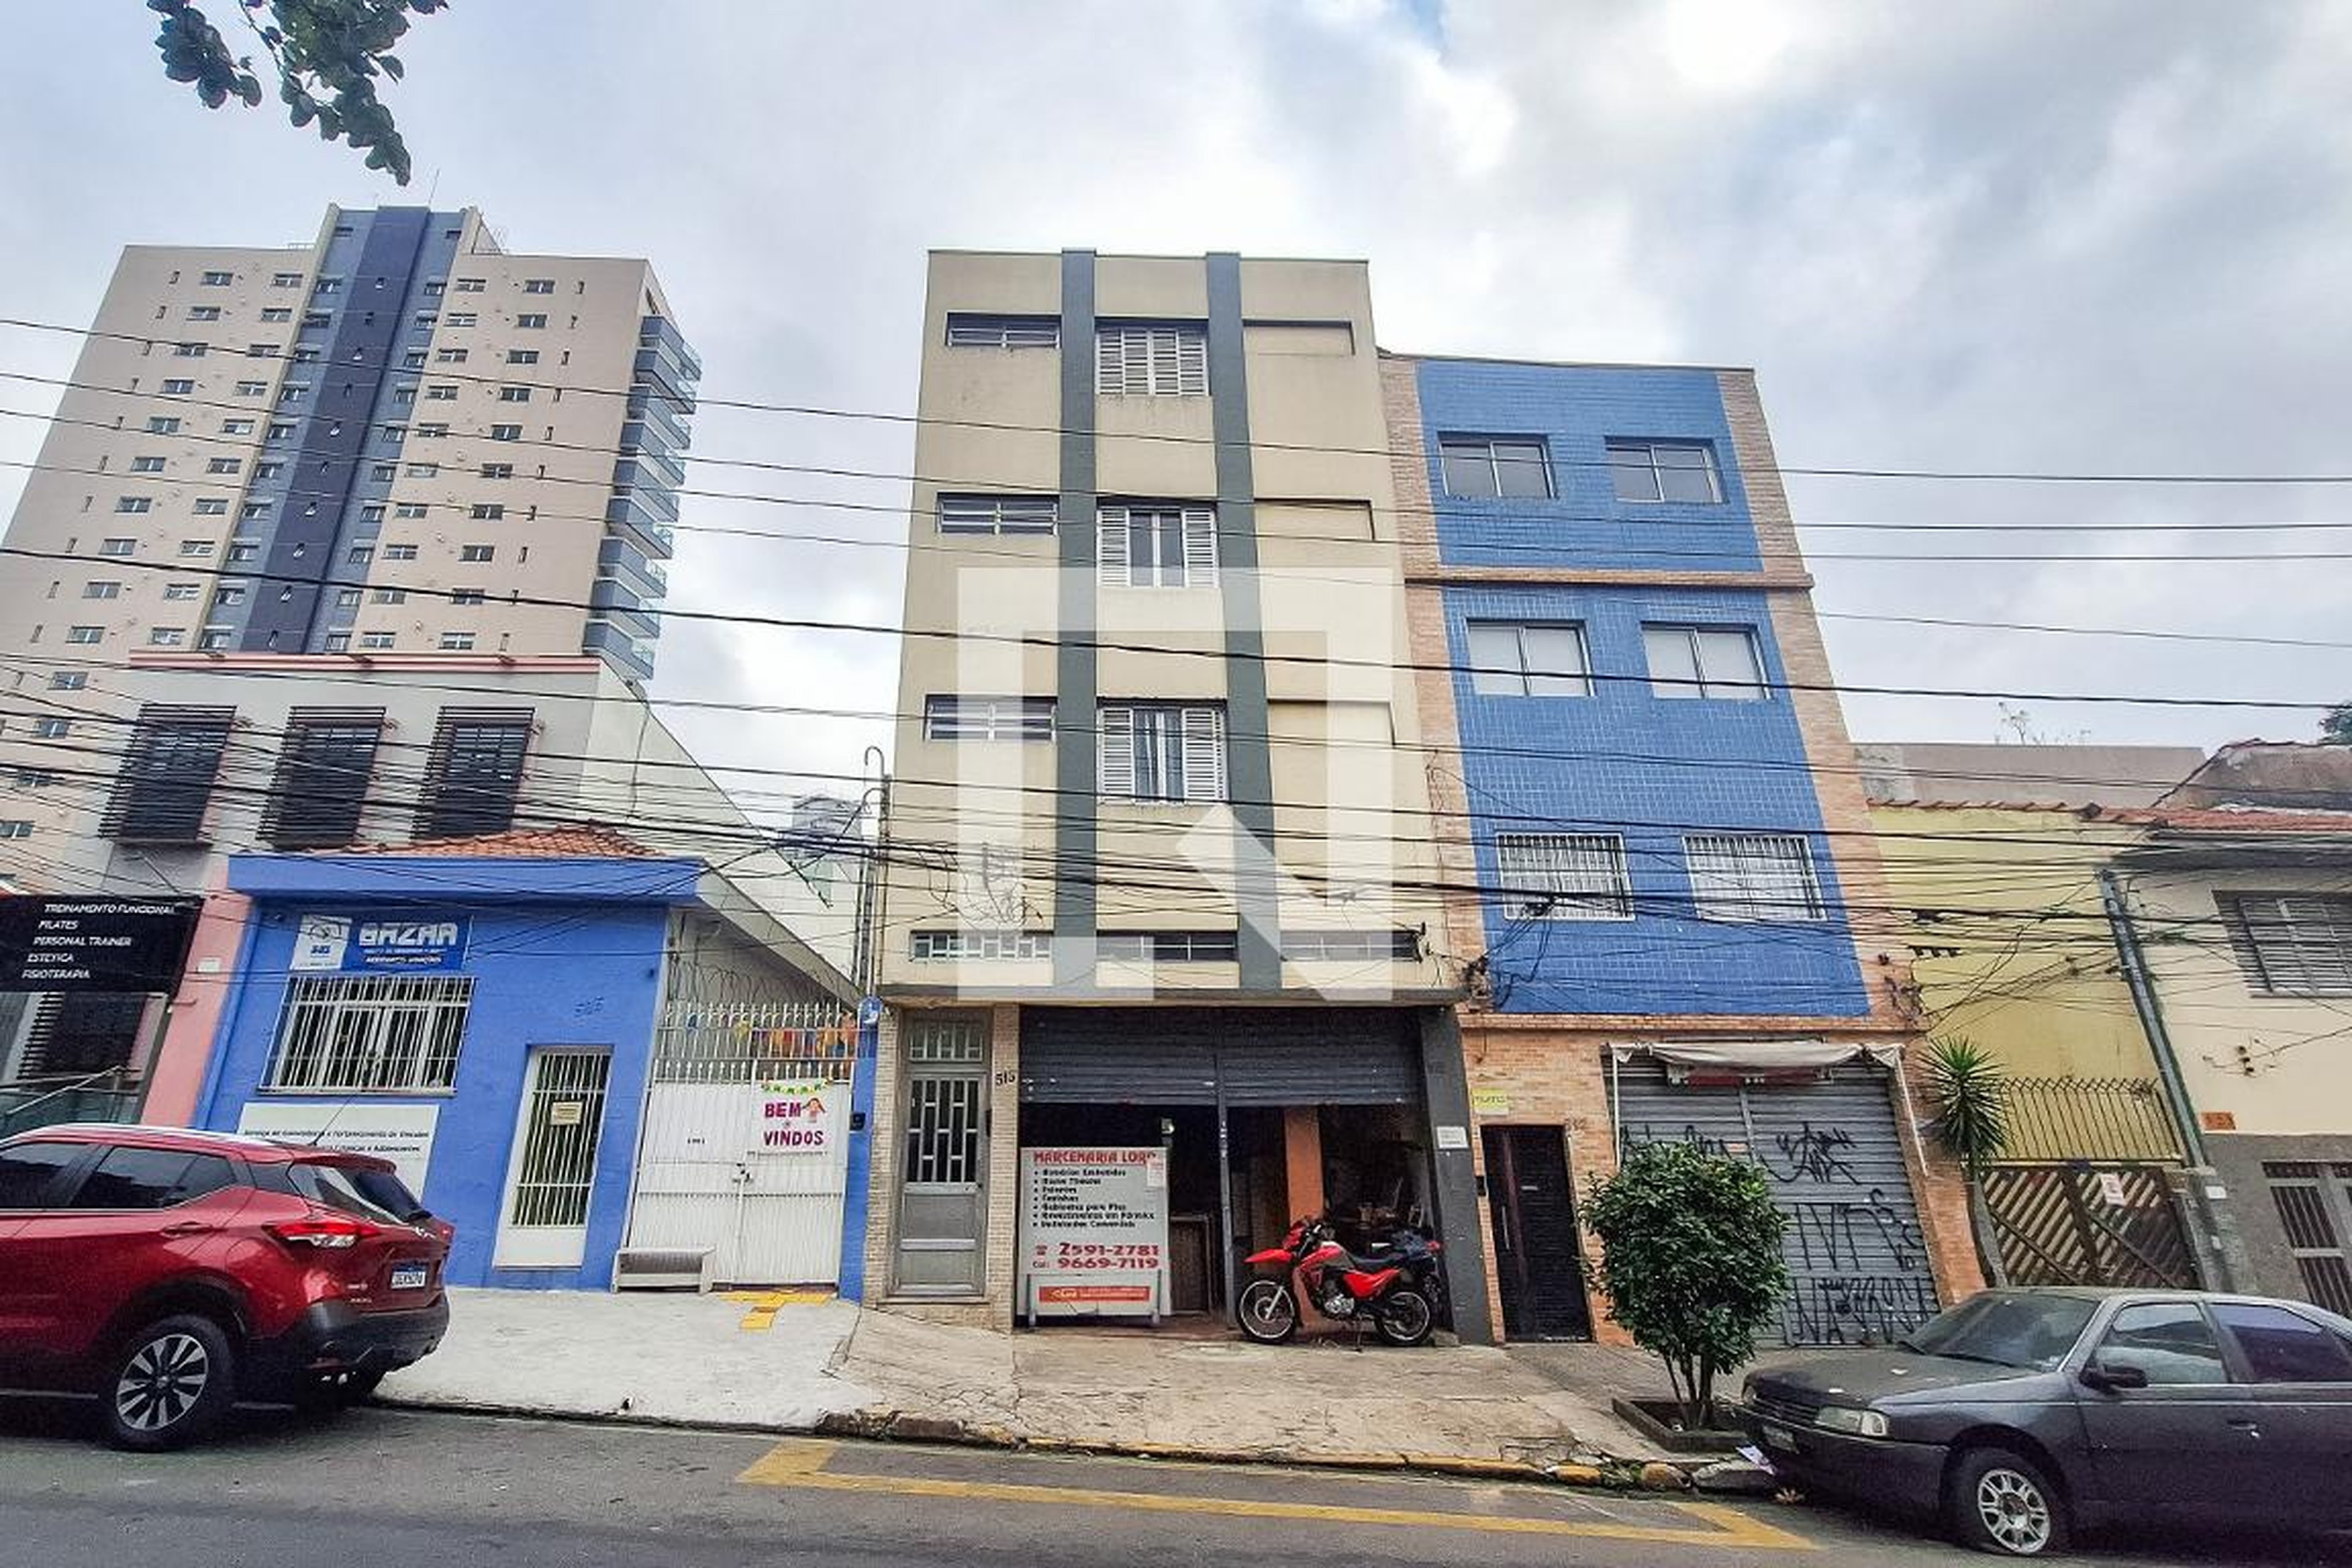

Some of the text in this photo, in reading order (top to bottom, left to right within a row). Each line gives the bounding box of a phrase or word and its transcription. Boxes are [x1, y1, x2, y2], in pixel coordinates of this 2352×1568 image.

[44, 903, 116, 913] TREINAMENTO
[38, 920, 79, 929] PILATES
[359, 922, 458, 945] BAZAR
[33, 937, 132, 946] PERSONAL TRAINER
[21, 969, 91, 979] FISIOTERAPIA
[764, 1102, 802, 1118] BEM
[763, 1130, 824, 1146] VINDOS
[1033, 1151, 1118, 1164] MARCENARIA
[1058, 1243, 1159, 1256] 2591-2781
[1058, 1257, 1159, 1269] 9669-7119
